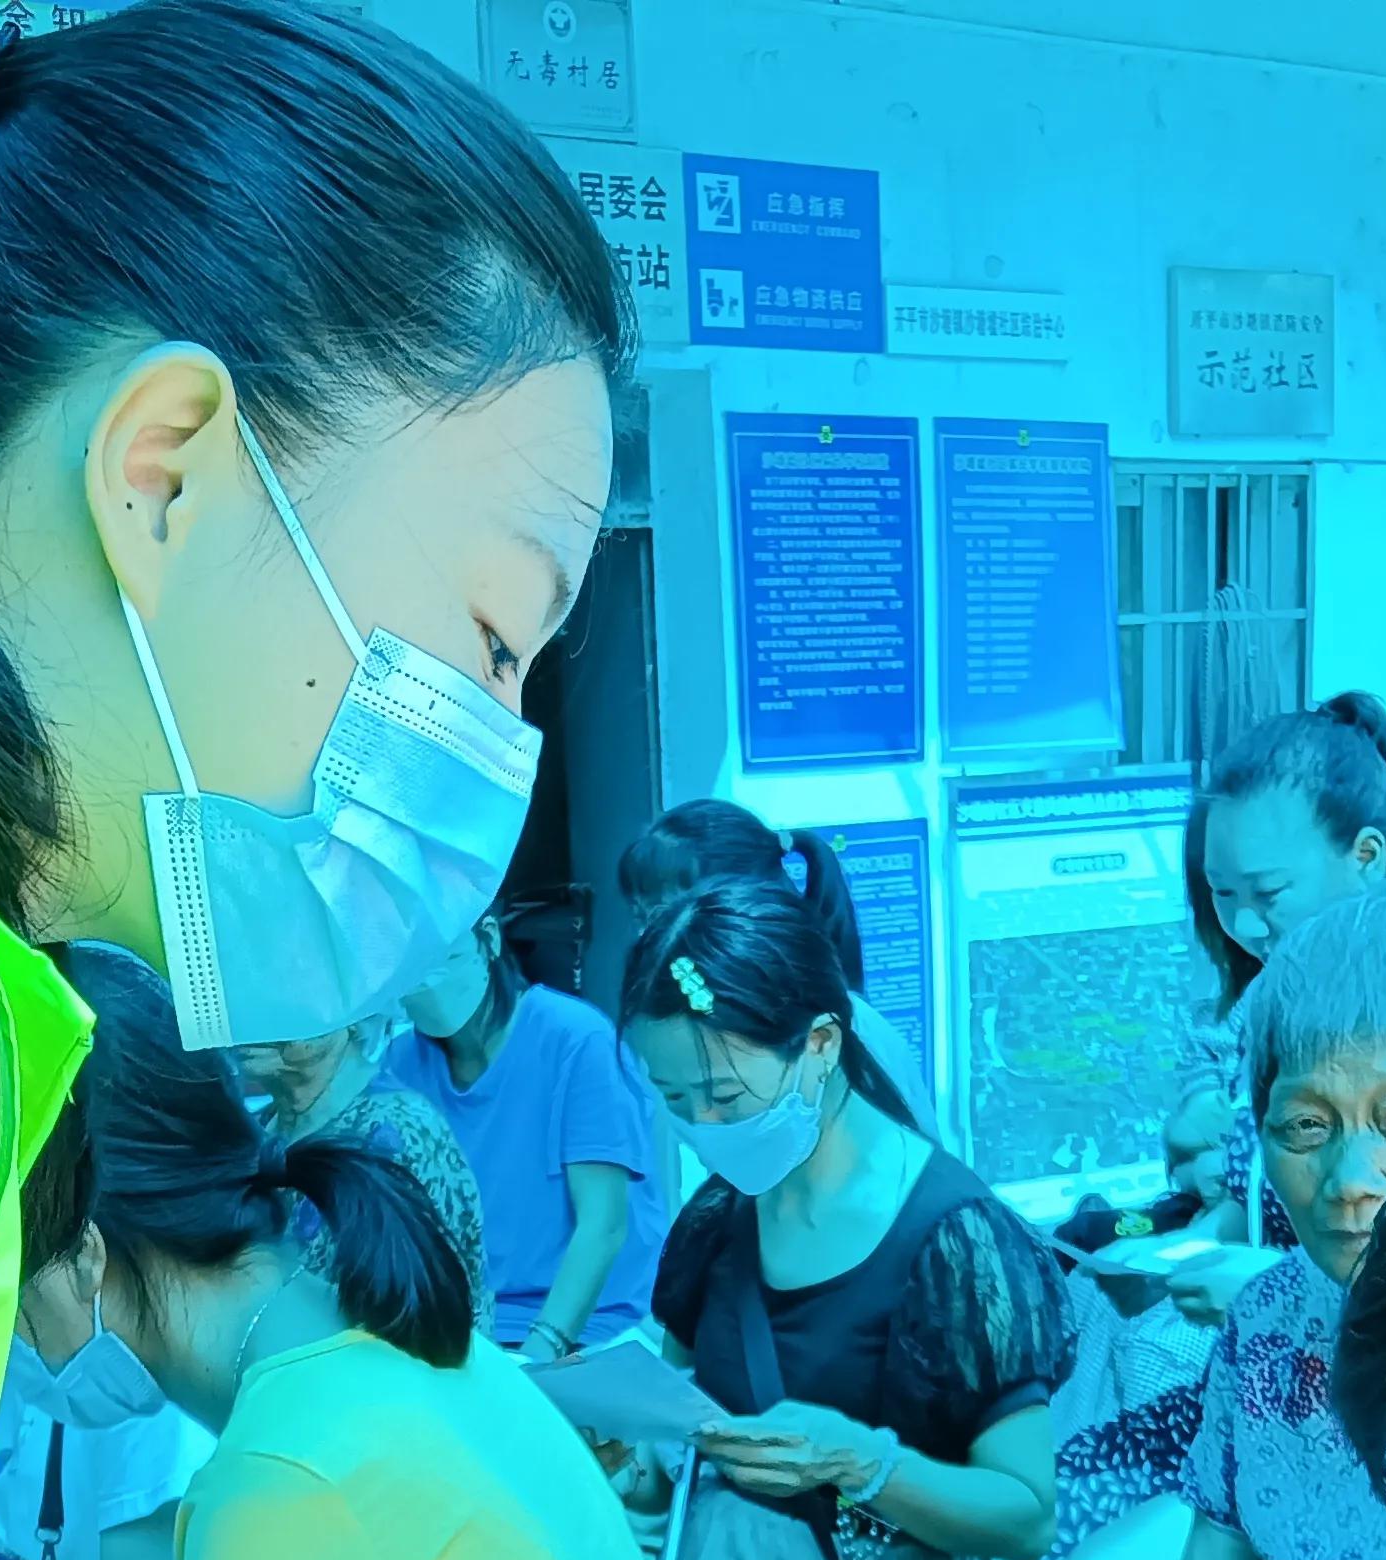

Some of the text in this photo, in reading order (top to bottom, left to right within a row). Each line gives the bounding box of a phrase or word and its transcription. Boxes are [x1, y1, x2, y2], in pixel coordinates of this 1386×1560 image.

[578, 172, 667, 222] 居委会
[767, 191, 846, 219] 应急指挥
[1197, 348, 1319, 393] 示范社区
